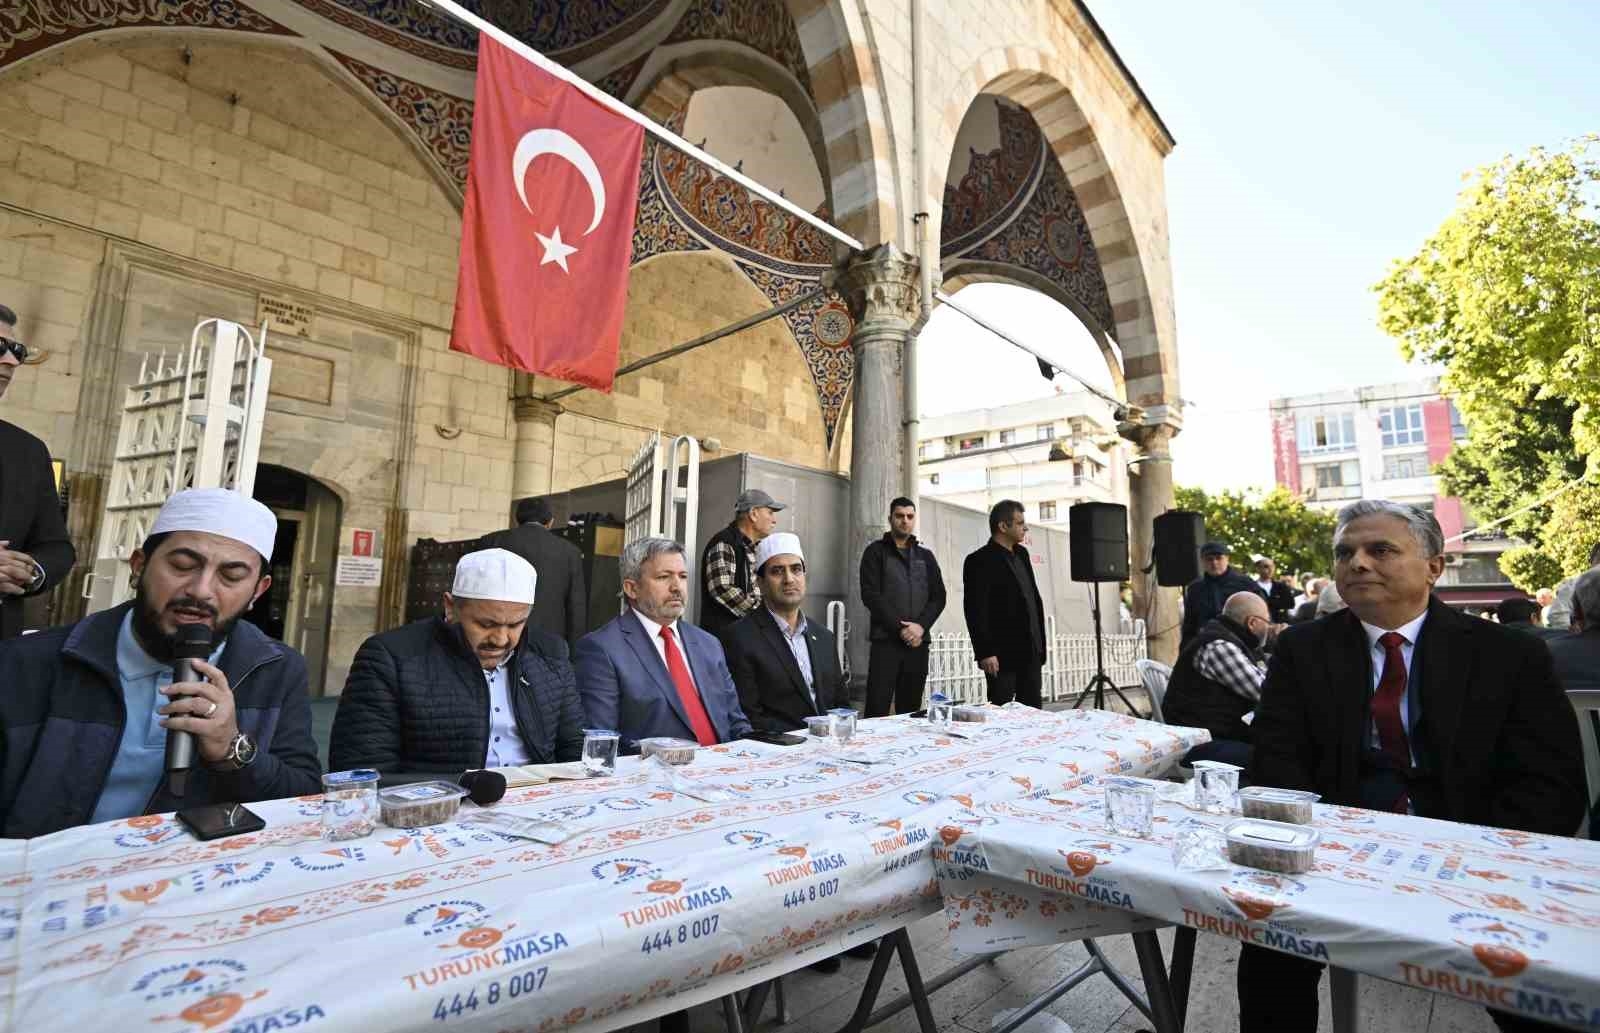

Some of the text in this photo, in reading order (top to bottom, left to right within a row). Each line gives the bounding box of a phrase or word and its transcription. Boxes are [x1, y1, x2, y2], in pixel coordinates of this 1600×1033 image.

[783, 878, 840, 909] 444 8 007
[641, 914, 720, 954] 444 8 007
[433, 966, 549, 1021] 444 8 007
